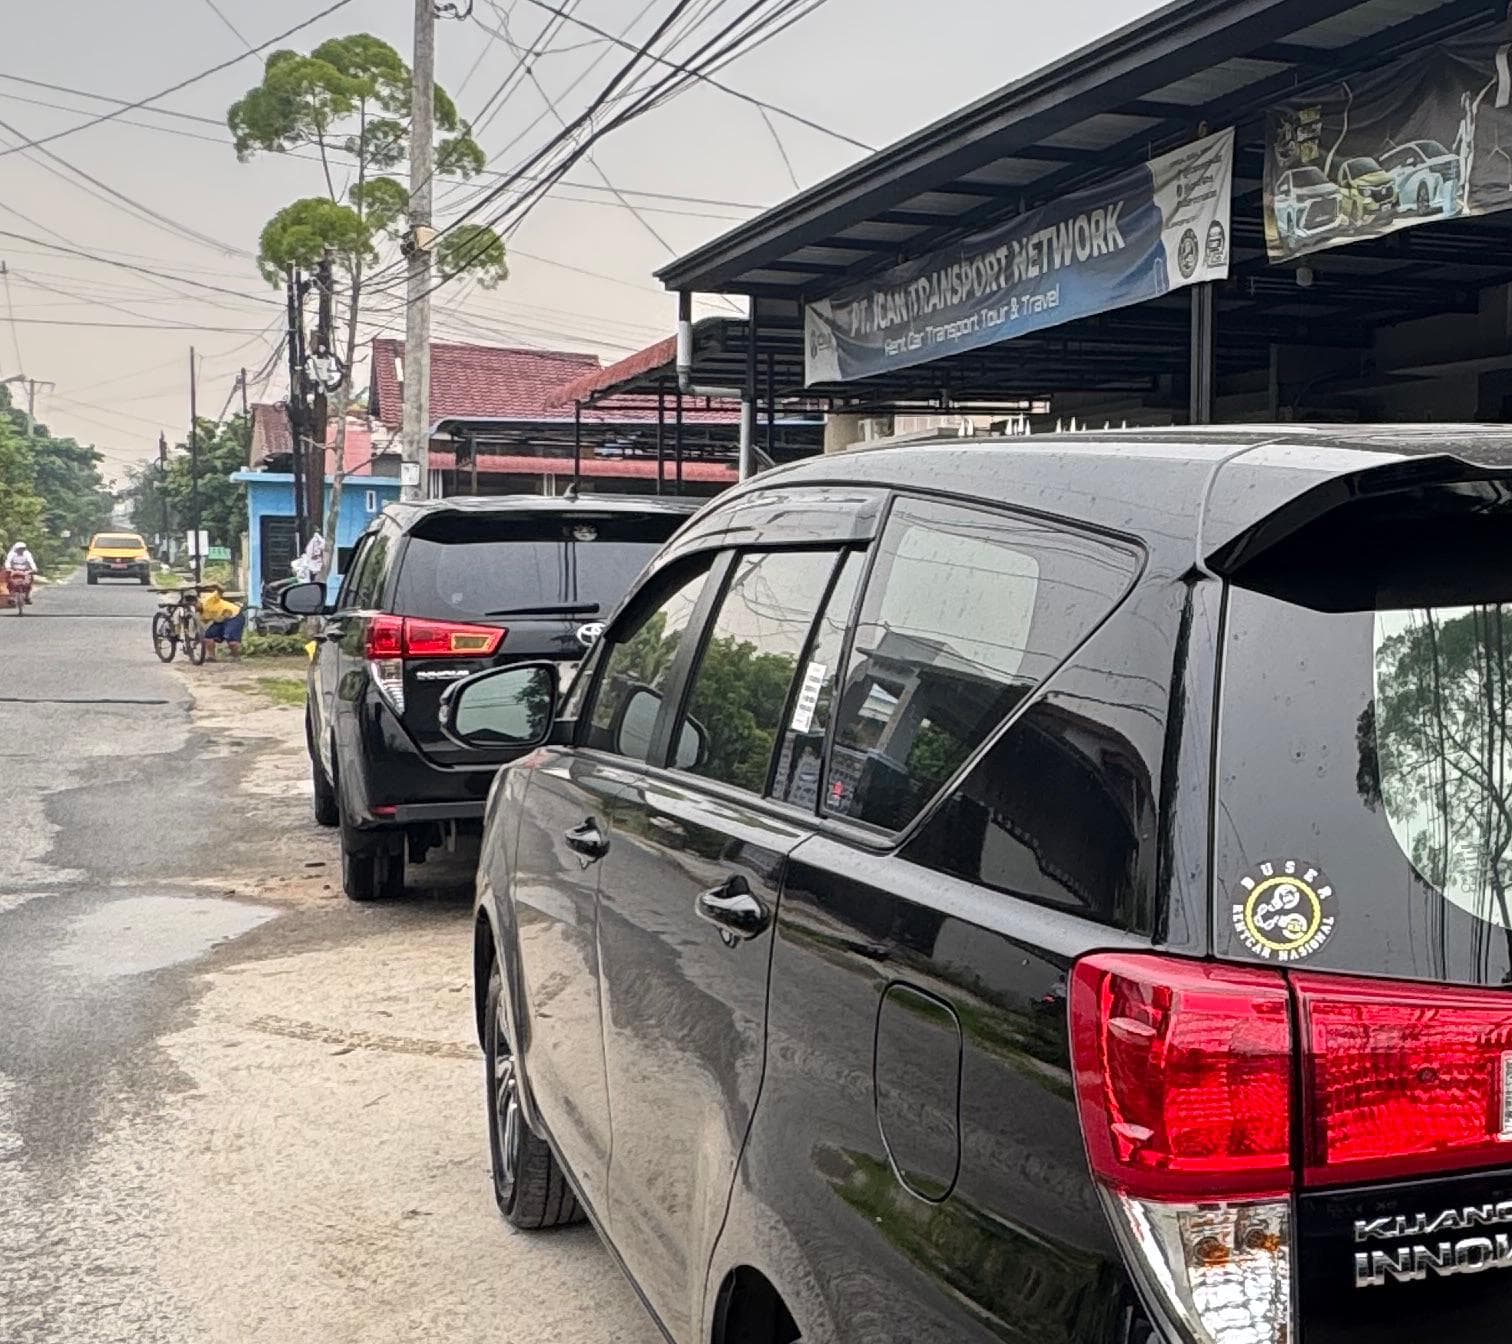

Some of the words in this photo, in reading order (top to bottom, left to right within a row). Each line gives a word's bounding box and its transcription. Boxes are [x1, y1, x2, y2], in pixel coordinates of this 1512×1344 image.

[907, 244, 1009, 316] TRANSPORT
[1012, 200, 1126, 284] NETWORK
[925, 312, 980, 343] Transport
[980, 305, 1009, 329] Tour
[1010, 296, 1019, 321] &
[1021, 282, 1060, 316] Travel
[1278, 915, 1335, 962] NASIONAL
